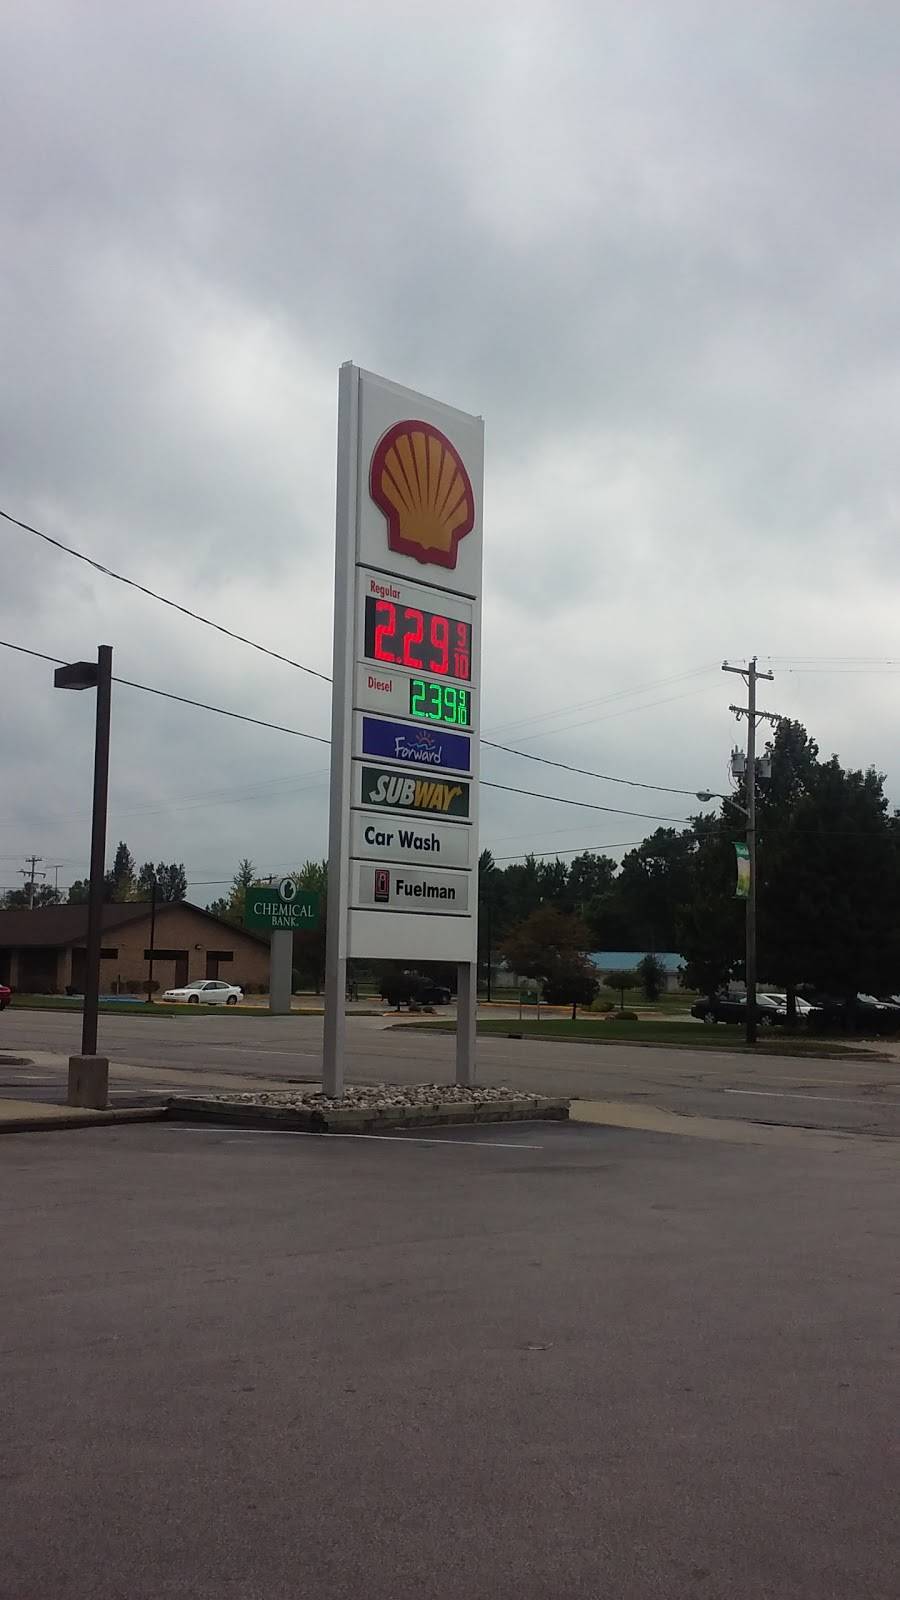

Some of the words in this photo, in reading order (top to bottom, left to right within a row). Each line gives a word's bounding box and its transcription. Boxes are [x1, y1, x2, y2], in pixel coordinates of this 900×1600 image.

[370, 580, 400, 599] Regular
[368, 676, 393, 692] Diesel
[394, 737, 442, 764] Forward
[369, 775, 463, 811] SUBWAY
[364, 826, 394, 846] Car
[399, 829, 440, 852] Wash
[396, 879, 456, 900] Fuelman
[253, 902, 314, 918] CHEMICAL
[271, 915, 297, 927] BANK
